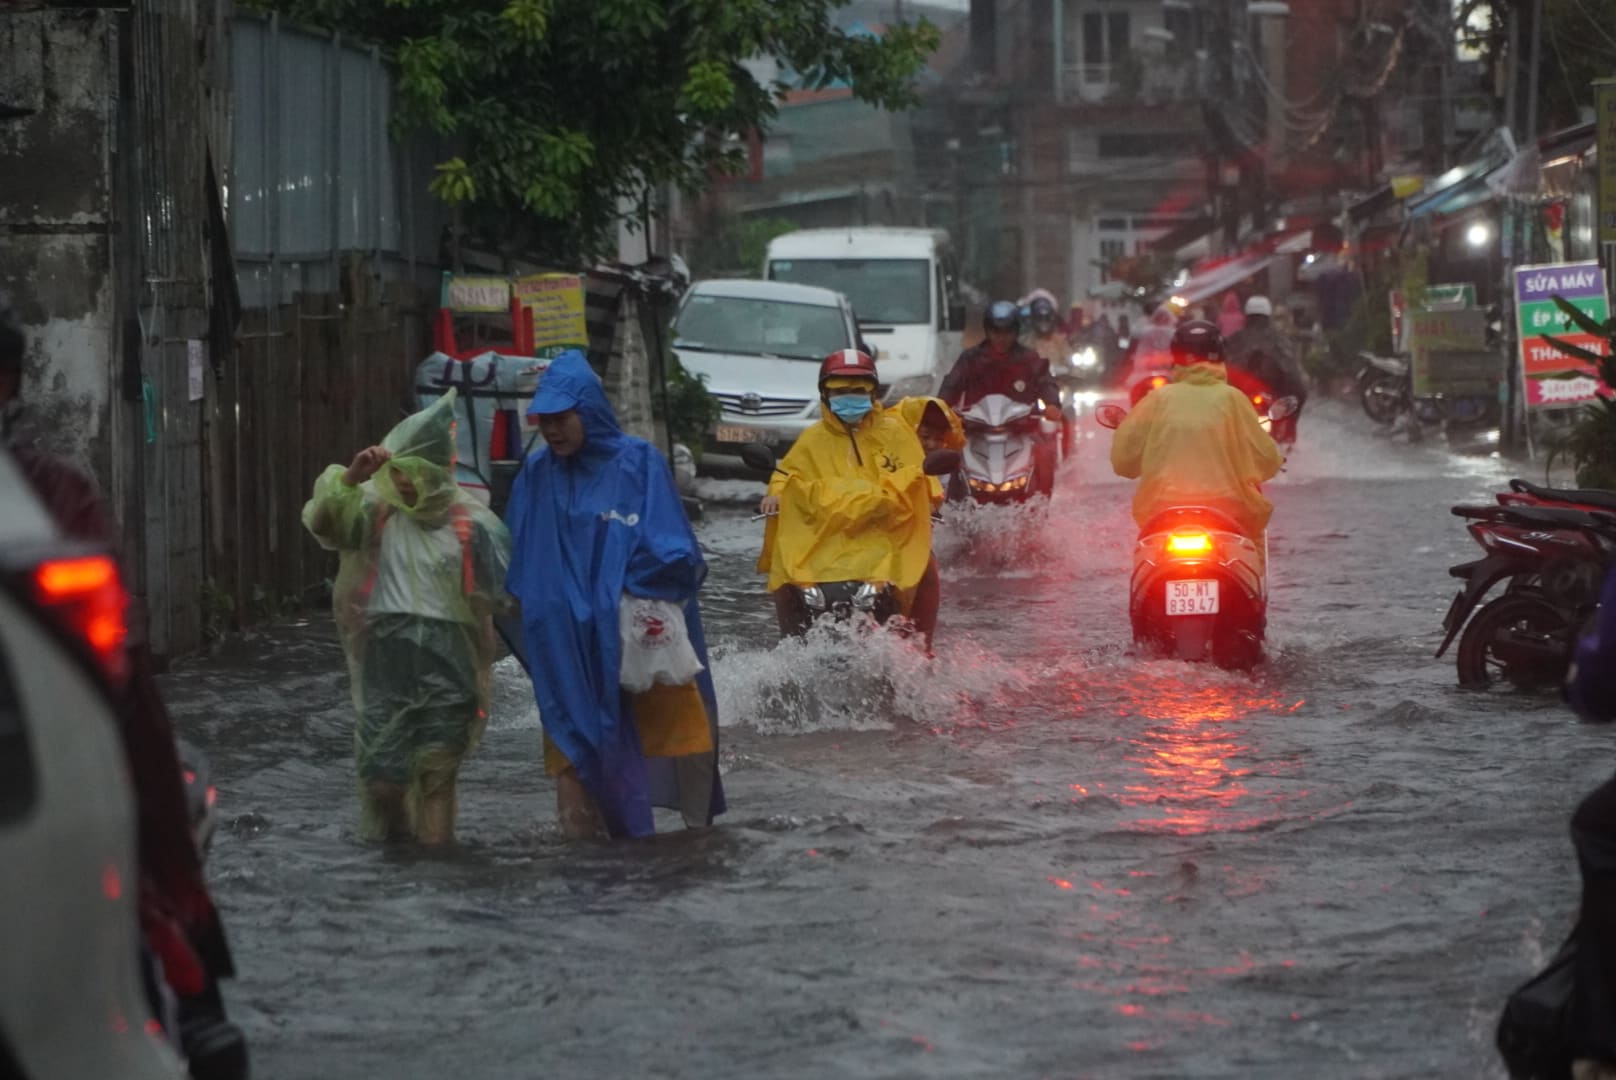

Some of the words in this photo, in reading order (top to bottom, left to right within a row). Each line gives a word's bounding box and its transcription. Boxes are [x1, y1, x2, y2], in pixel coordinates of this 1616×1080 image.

[1525, 273, 1559, 293] SỬA
[1562, 271, 1595, 289] MÁY
[1533, 308, 1551, 327] ÉP
[1530, 346, 1571, 361] THA
